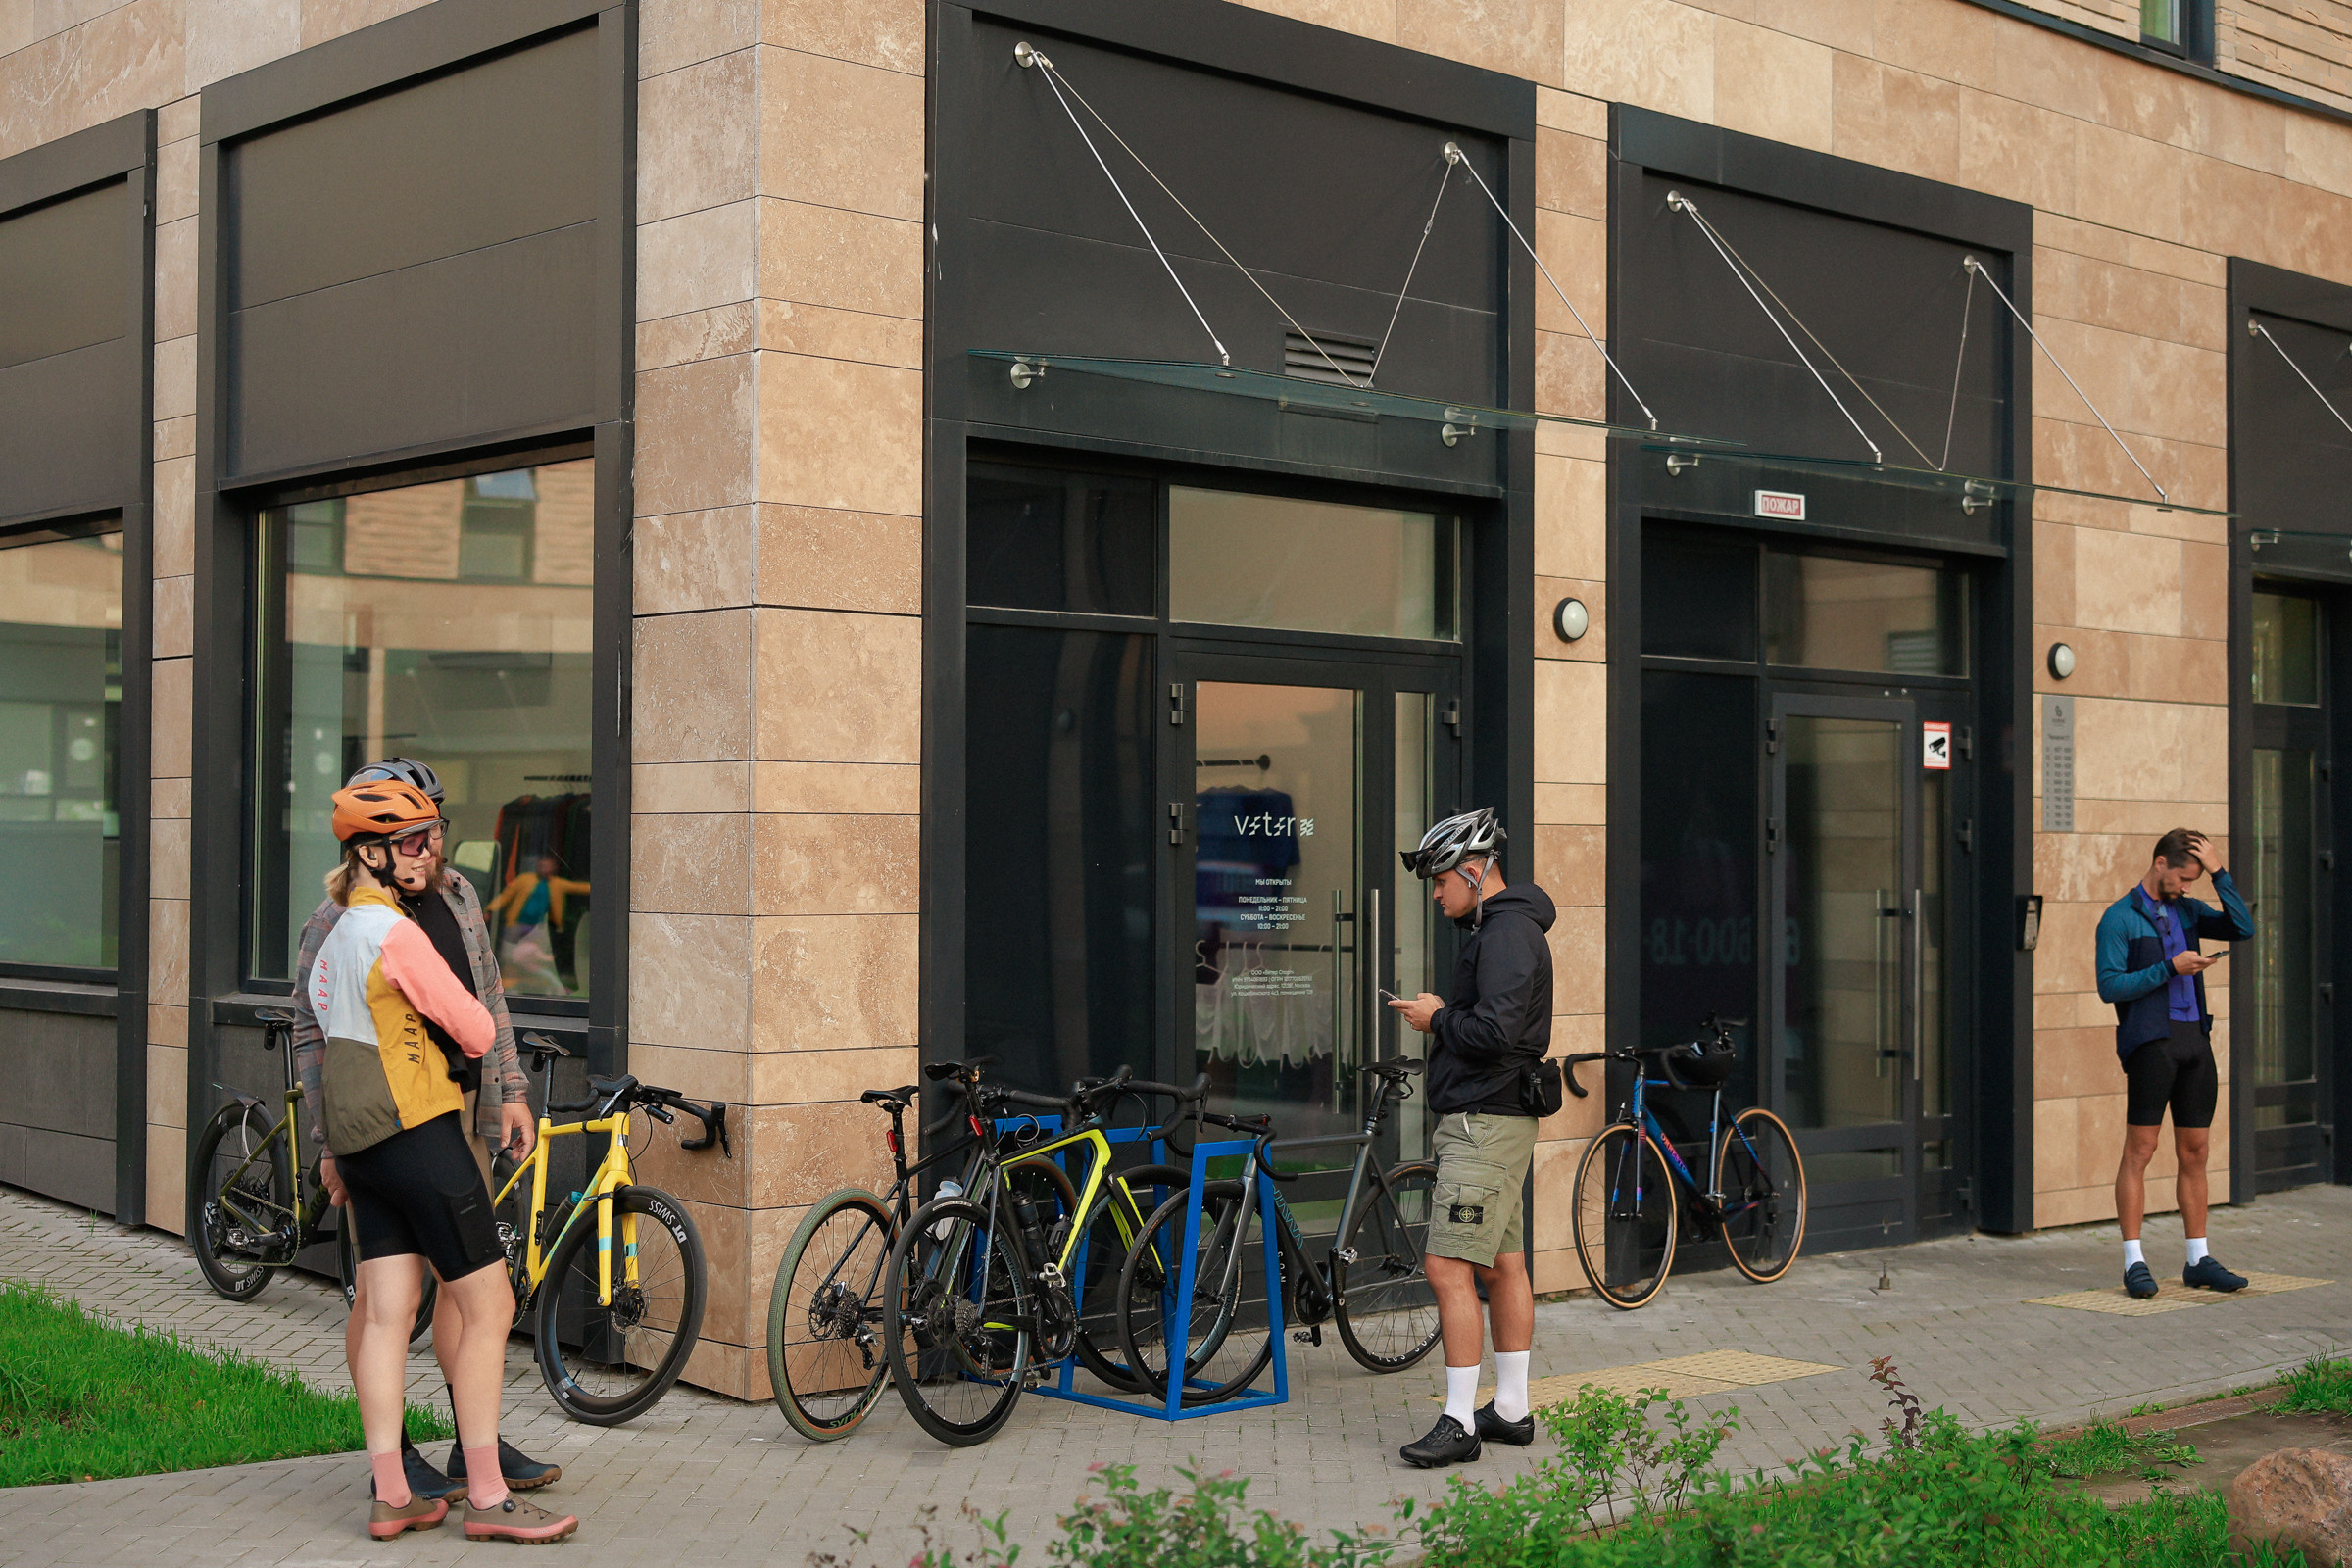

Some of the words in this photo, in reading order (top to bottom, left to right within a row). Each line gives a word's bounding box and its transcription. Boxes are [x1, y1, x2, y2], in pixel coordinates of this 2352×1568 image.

[1763, 497, 1799, 514] ПОЖАР
[318, 959, 328, 1011] MAAP
[404, 1013, 420, 1064] MAAP
[649, 1200, 676, 1225] SWISS
[672, 1224, 688, 1244] DT
[235, 1279, 245, 1292] DT
